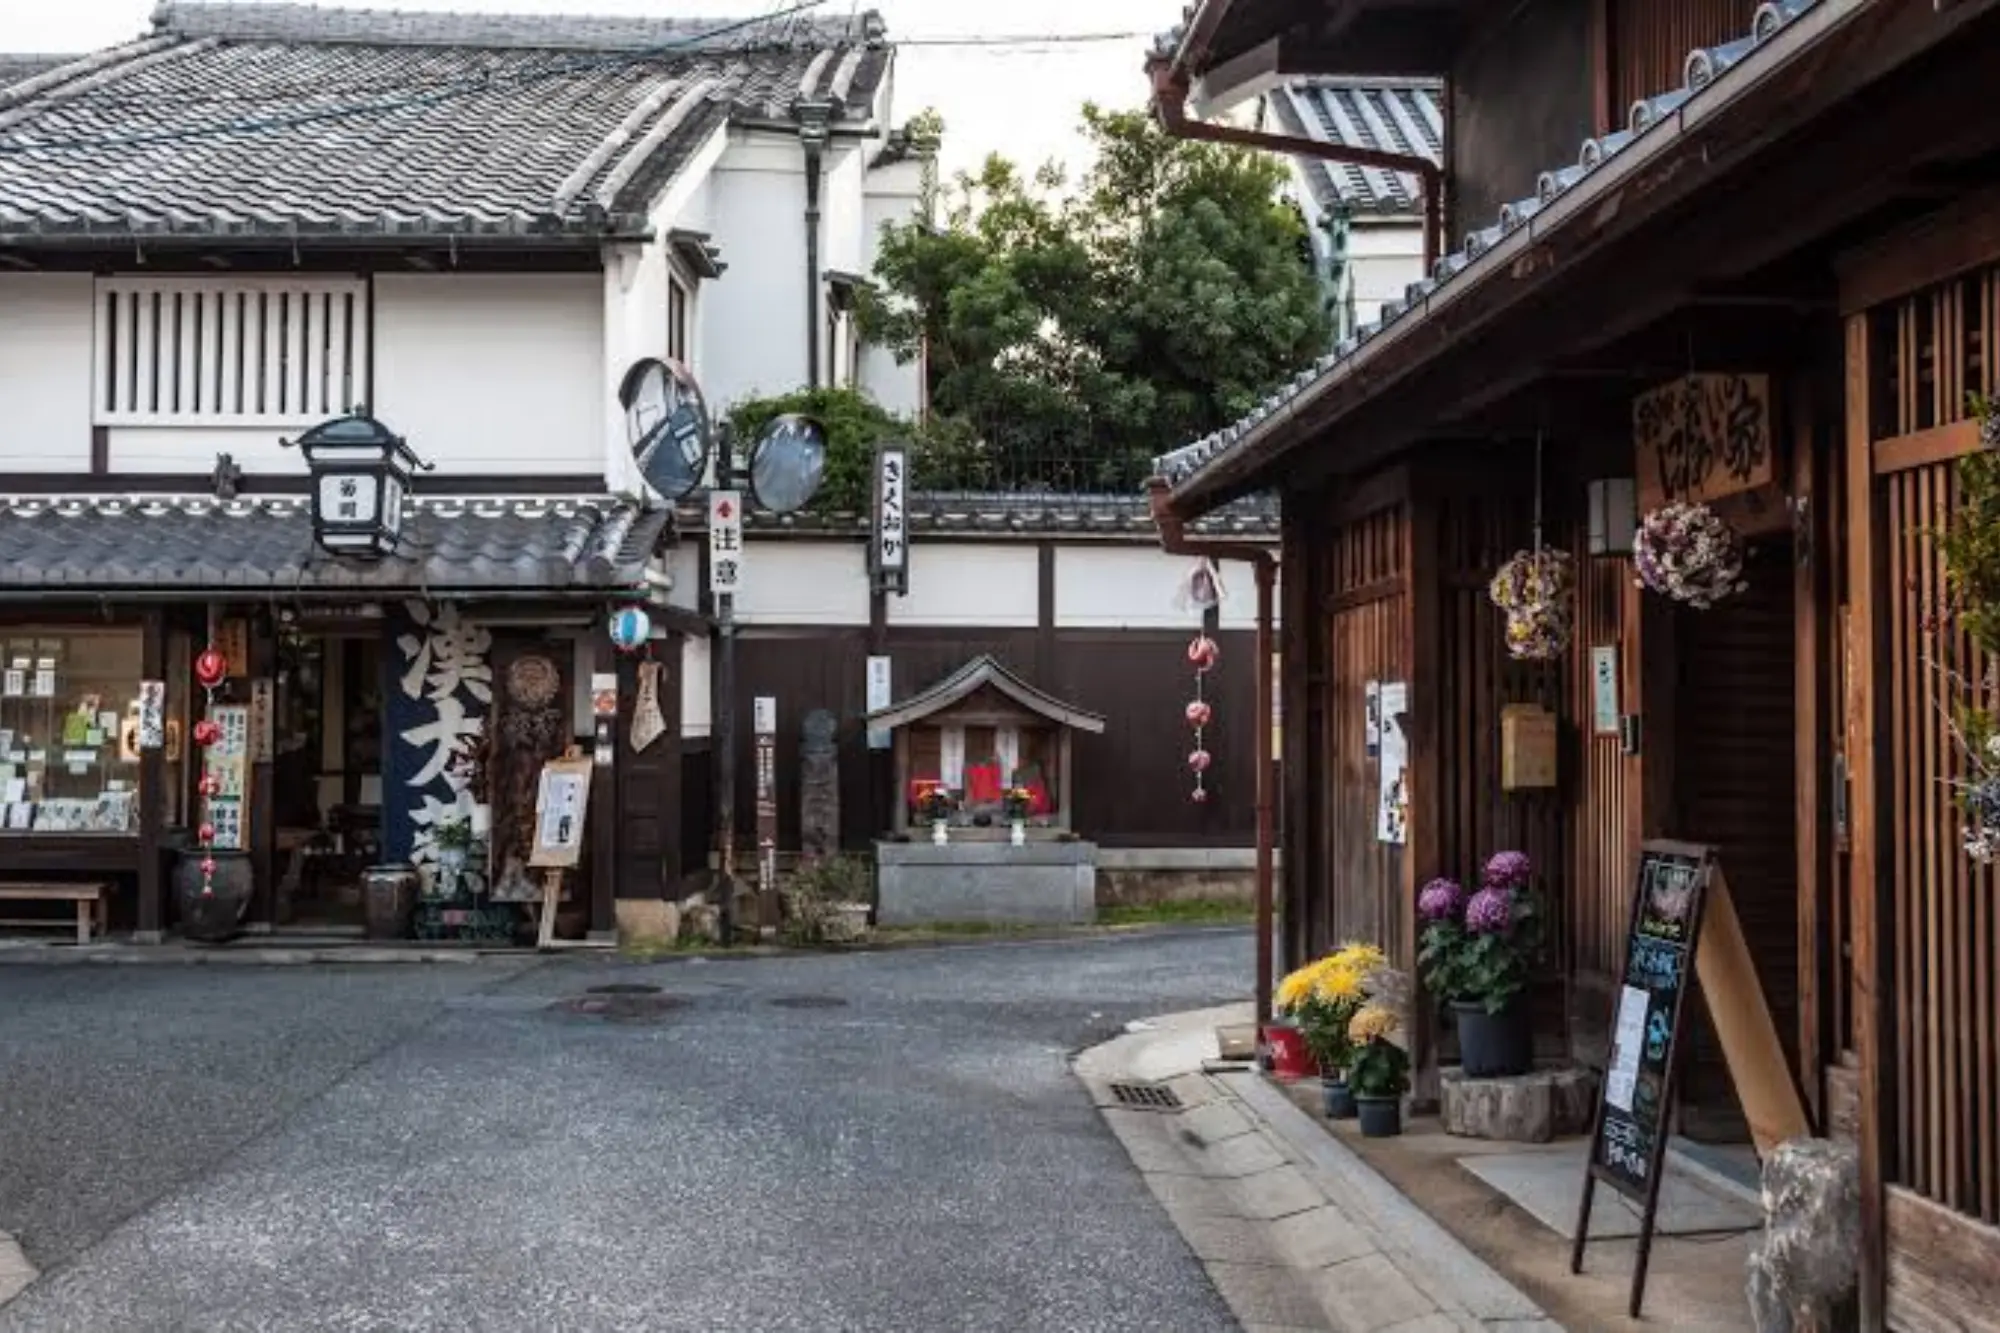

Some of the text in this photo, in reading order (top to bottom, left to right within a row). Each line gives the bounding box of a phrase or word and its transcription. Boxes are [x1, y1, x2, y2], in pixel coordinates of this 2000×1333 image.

[883, 460, 901, 557] きくおか
[712, 526, 738, 585] 注意
